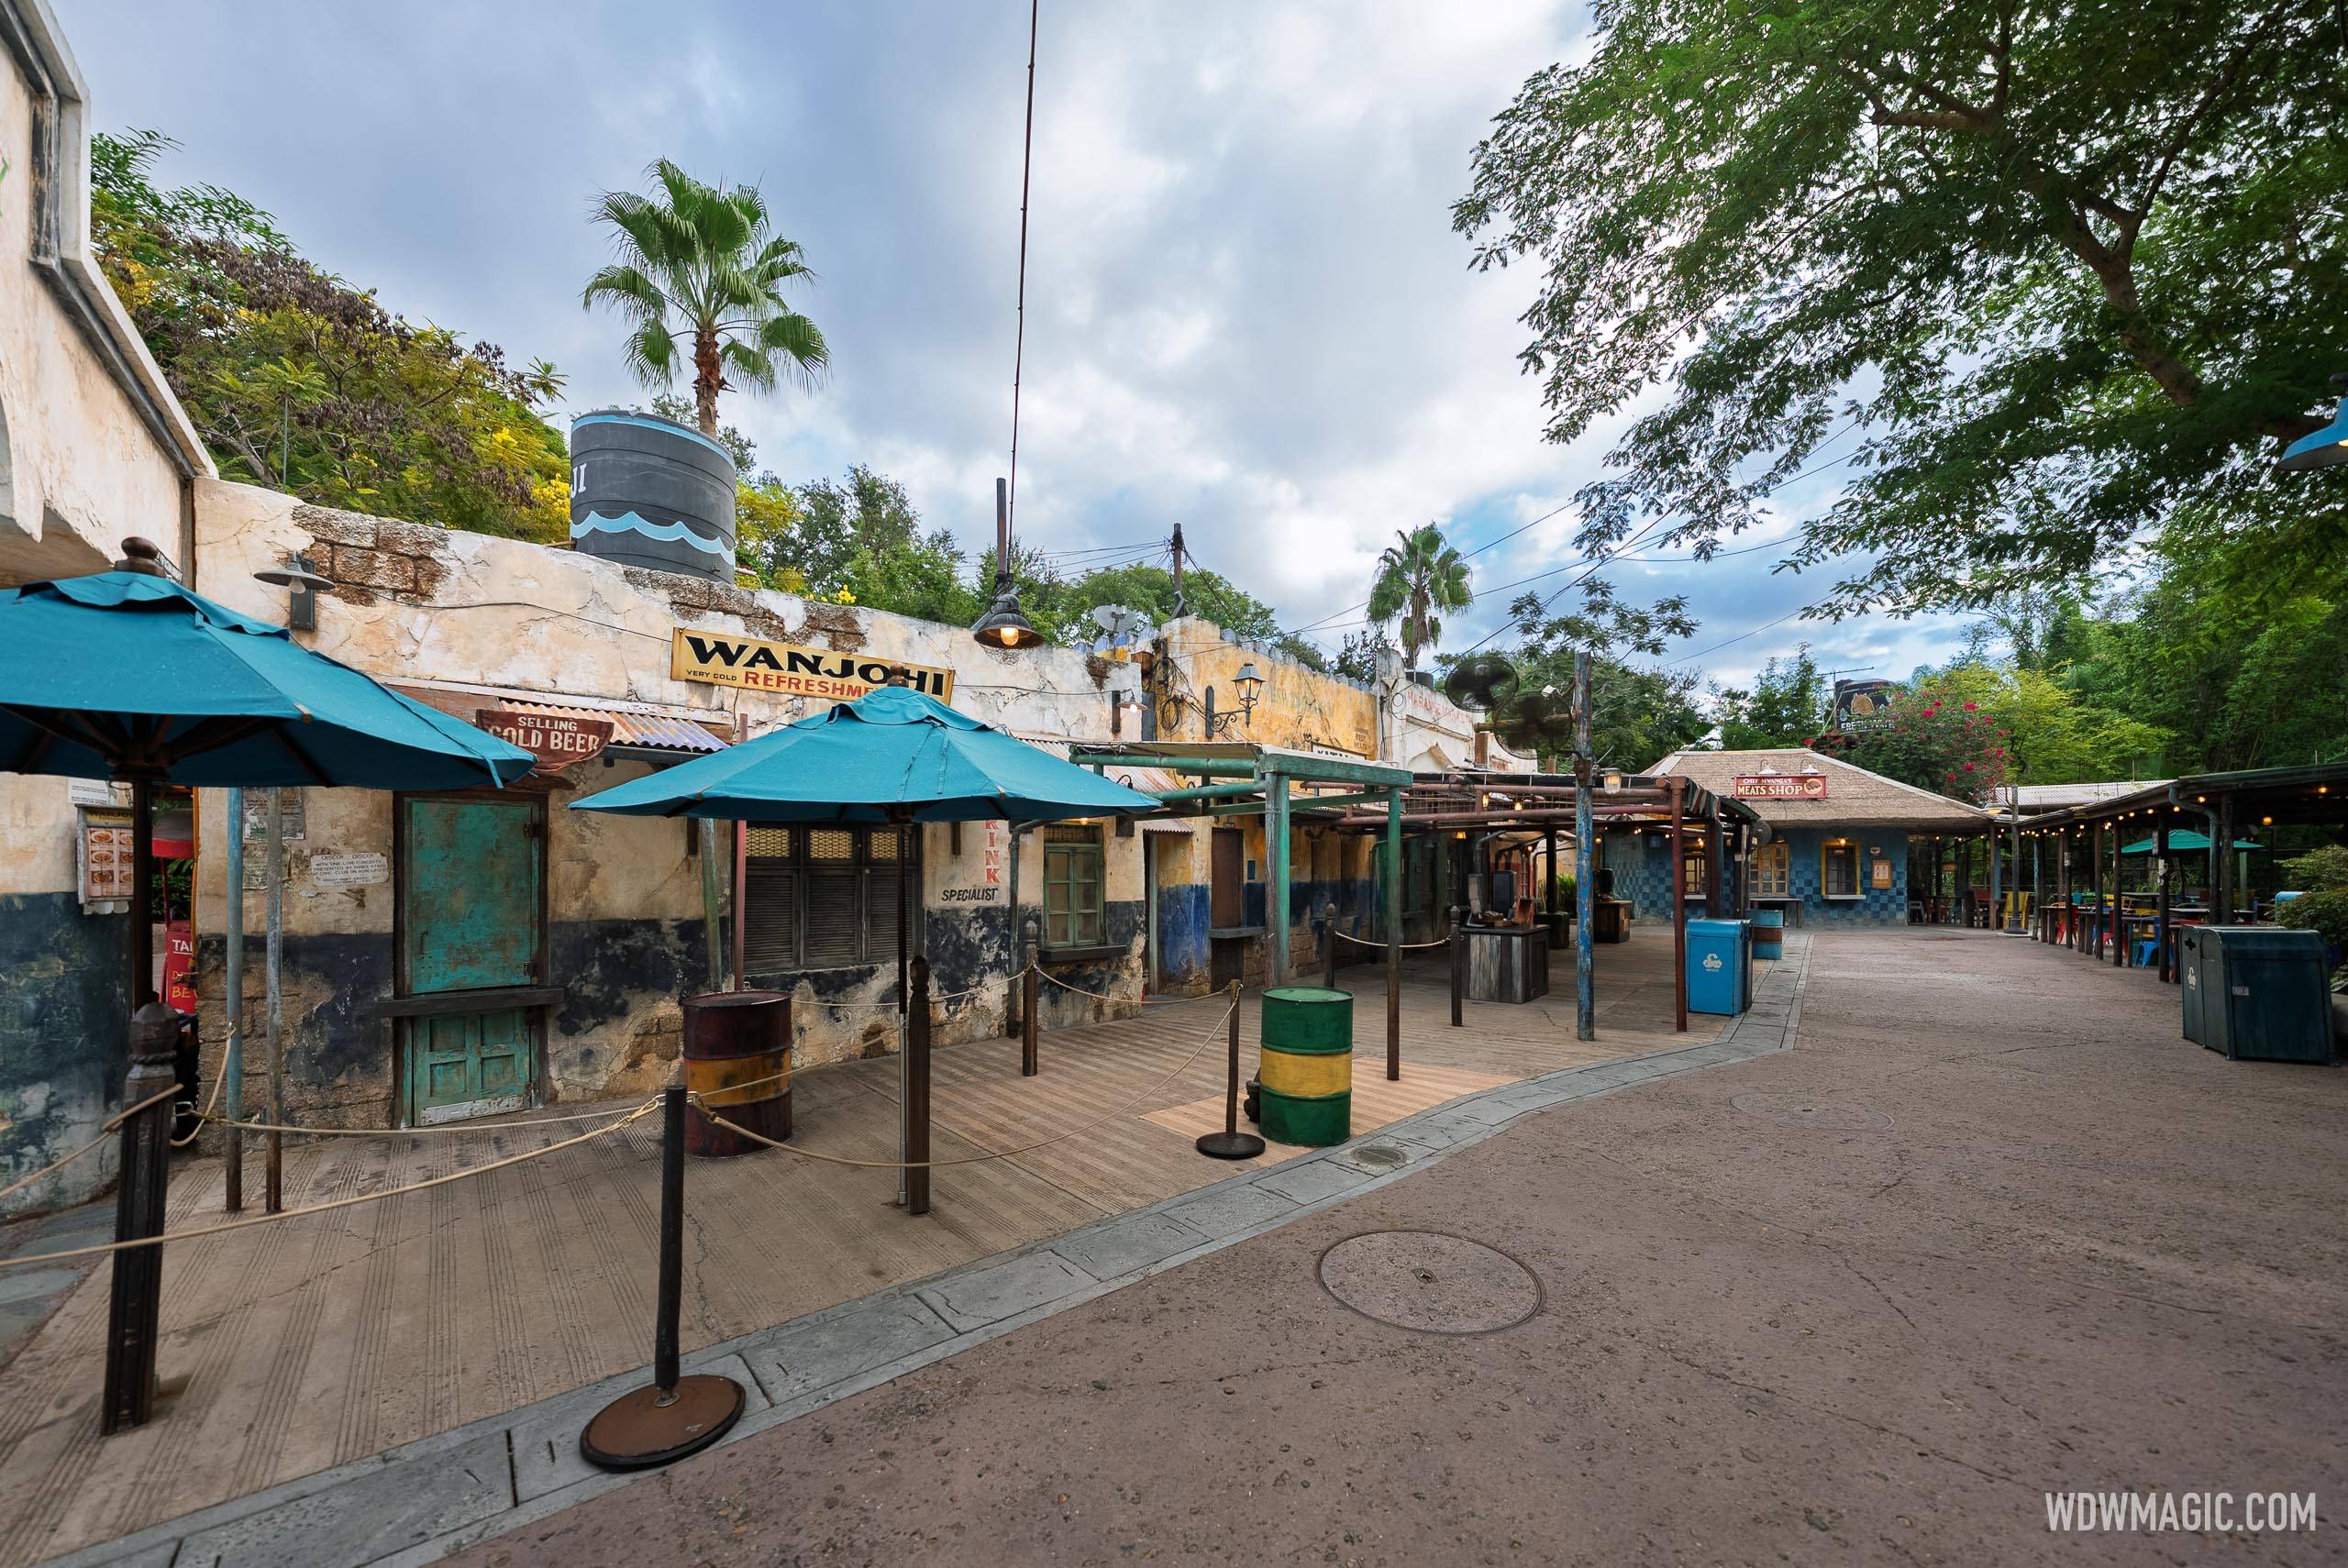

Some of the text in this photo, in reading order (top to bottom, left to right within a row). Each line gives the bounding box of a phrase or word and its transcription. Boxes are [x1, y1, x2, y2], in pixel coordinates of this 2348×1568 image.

[684, 635, 945, 697] WANJOHI
[686, 669, 711, 678] VERY
[713, 673, 737, 681] COLD
[517, 716, 578, 732] SELLING
[550, 731, 600, 752] BEER
[1737, 785, 1803, 795] MEATS SHOP
[941, 888, 999, 901] SPECIALIST
